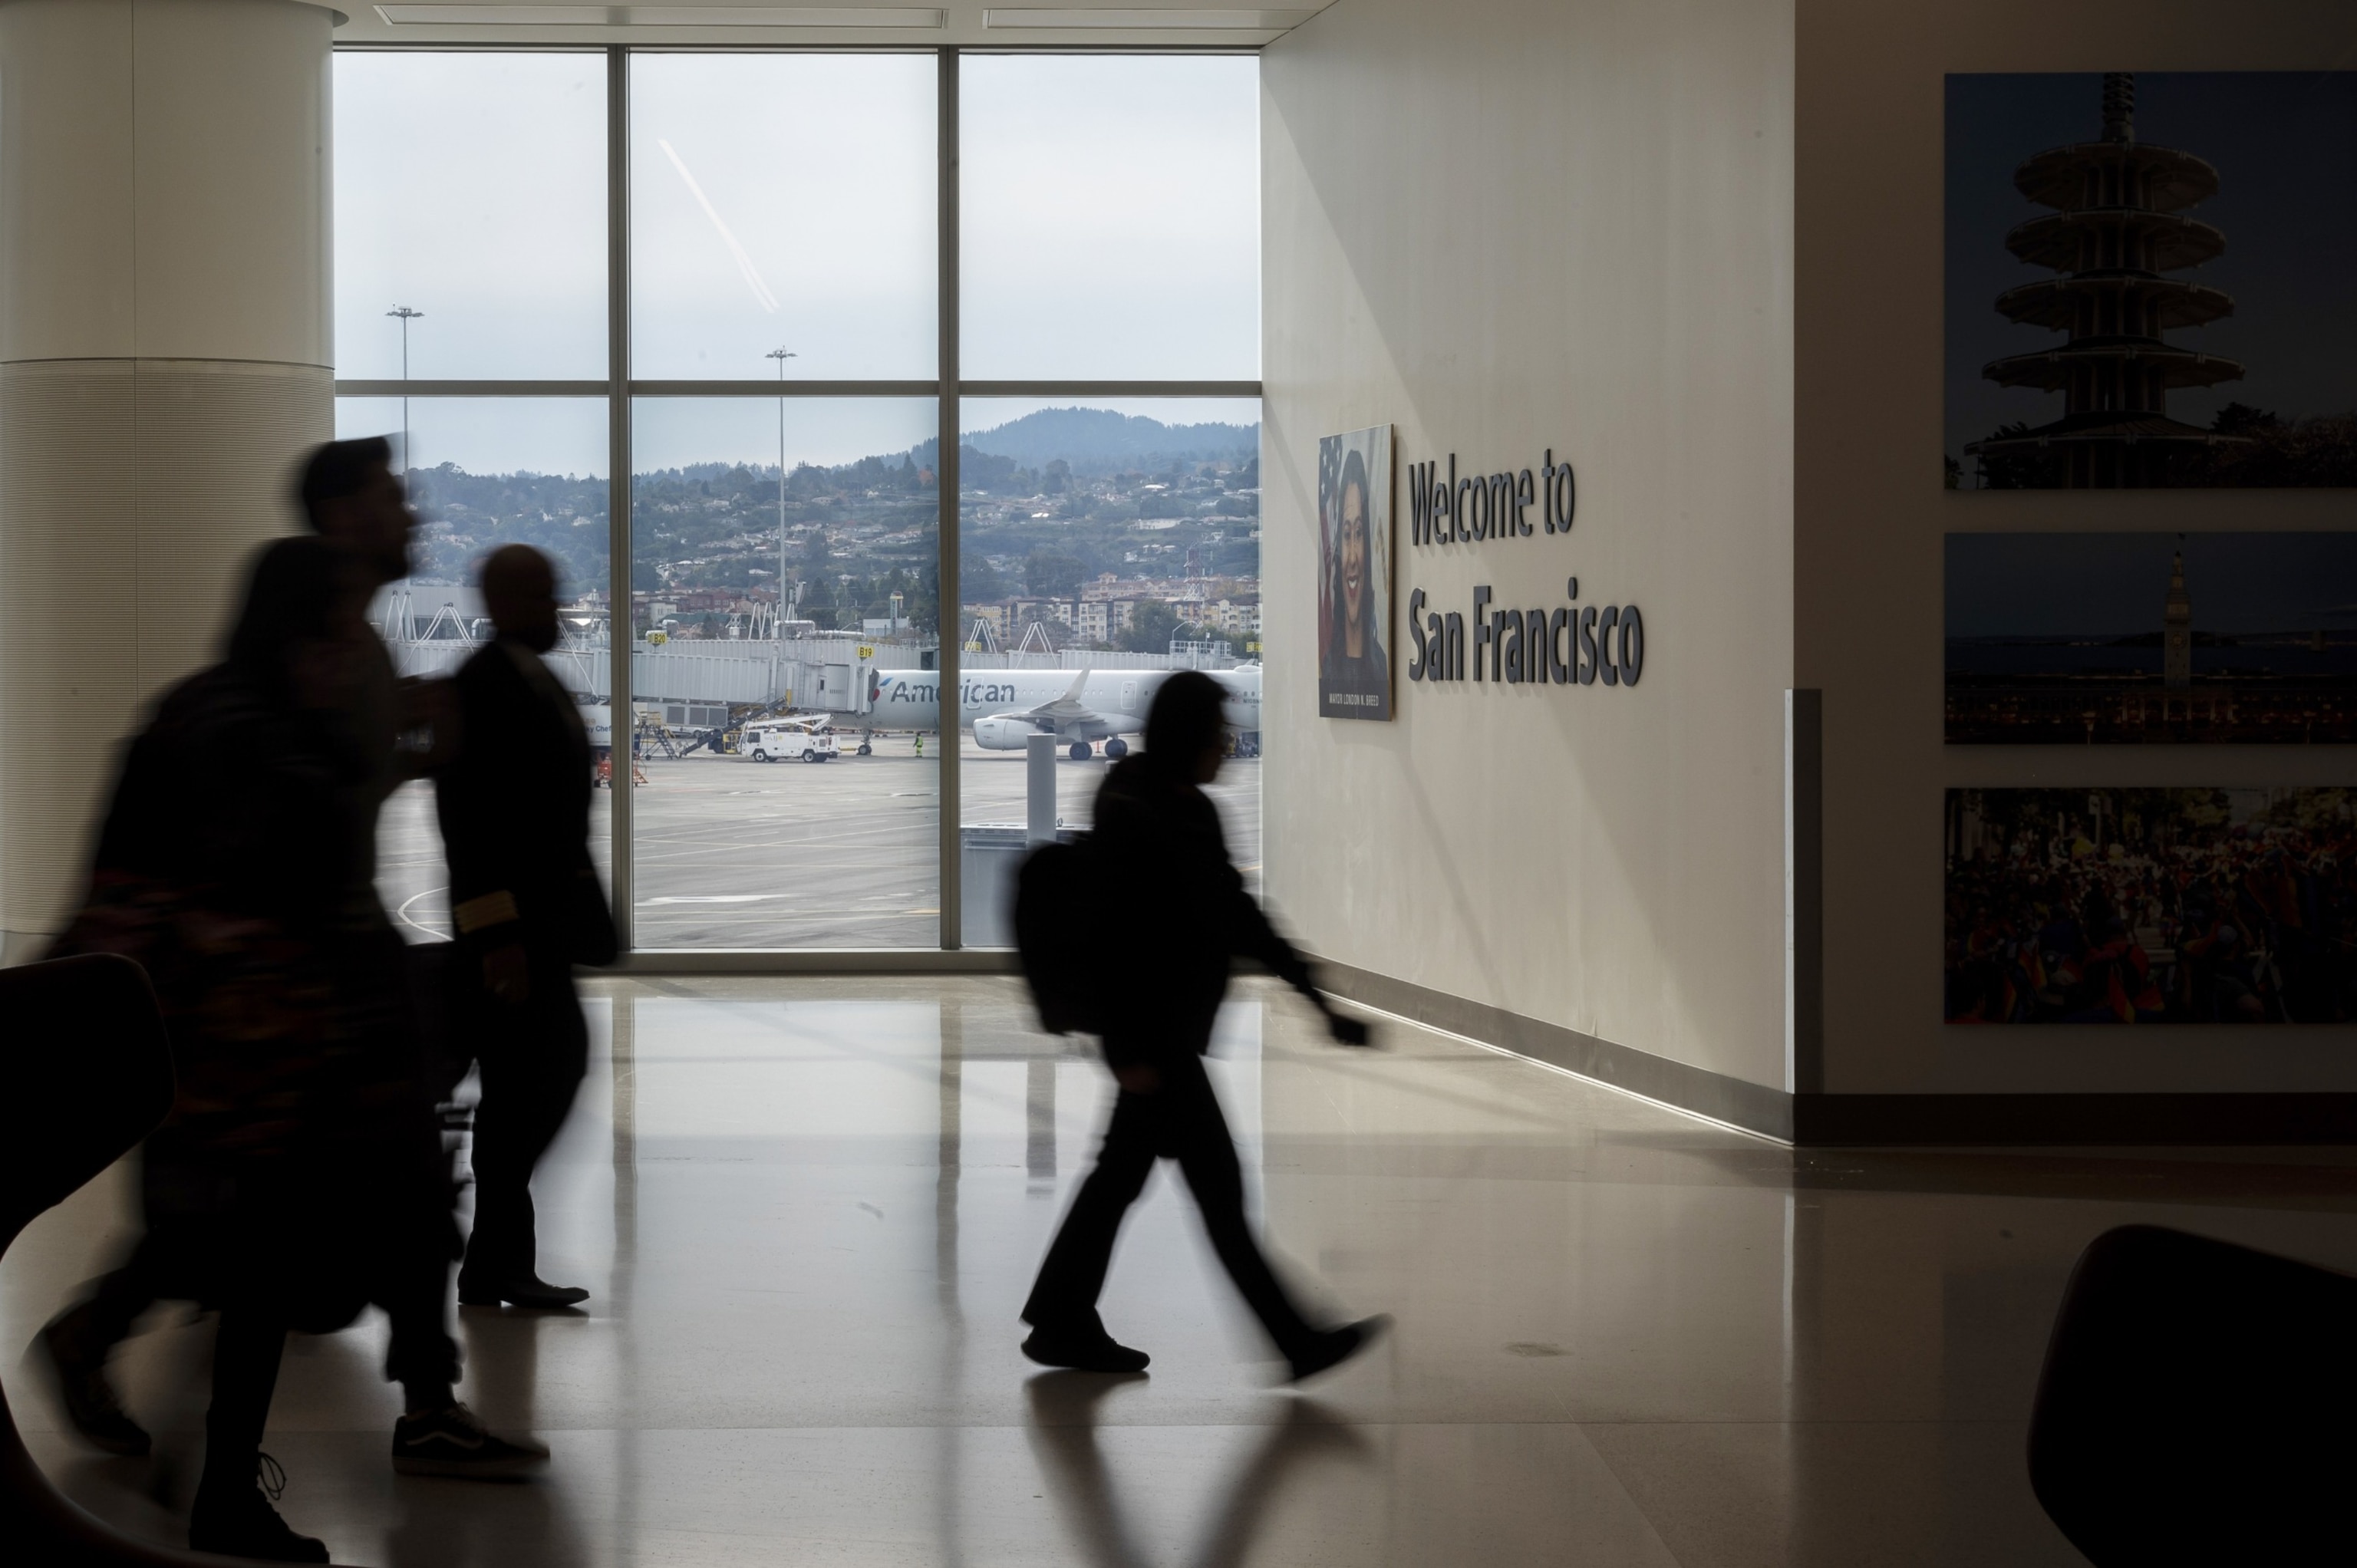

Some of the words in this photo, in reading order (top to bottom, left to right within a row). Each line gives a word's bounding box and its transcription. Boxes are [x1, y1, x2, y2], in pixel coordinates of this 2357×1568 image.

[1408, 453, 1535, 546] Welcome
[1541, 448, 1575, 535] to
[654, 633, 666, 644] B20
[1409, 587, 1465, 682] San
[1472, 576, 1644, 687] Francisco
[859, 647, 872, 657] B19
[890, 678, 1015, 704] Amican
[1329, 693, 1343, 705] MAYOR
[1343, 693, 1360, 706] LONDON
[1366, 694, 1380, 707] BREED
